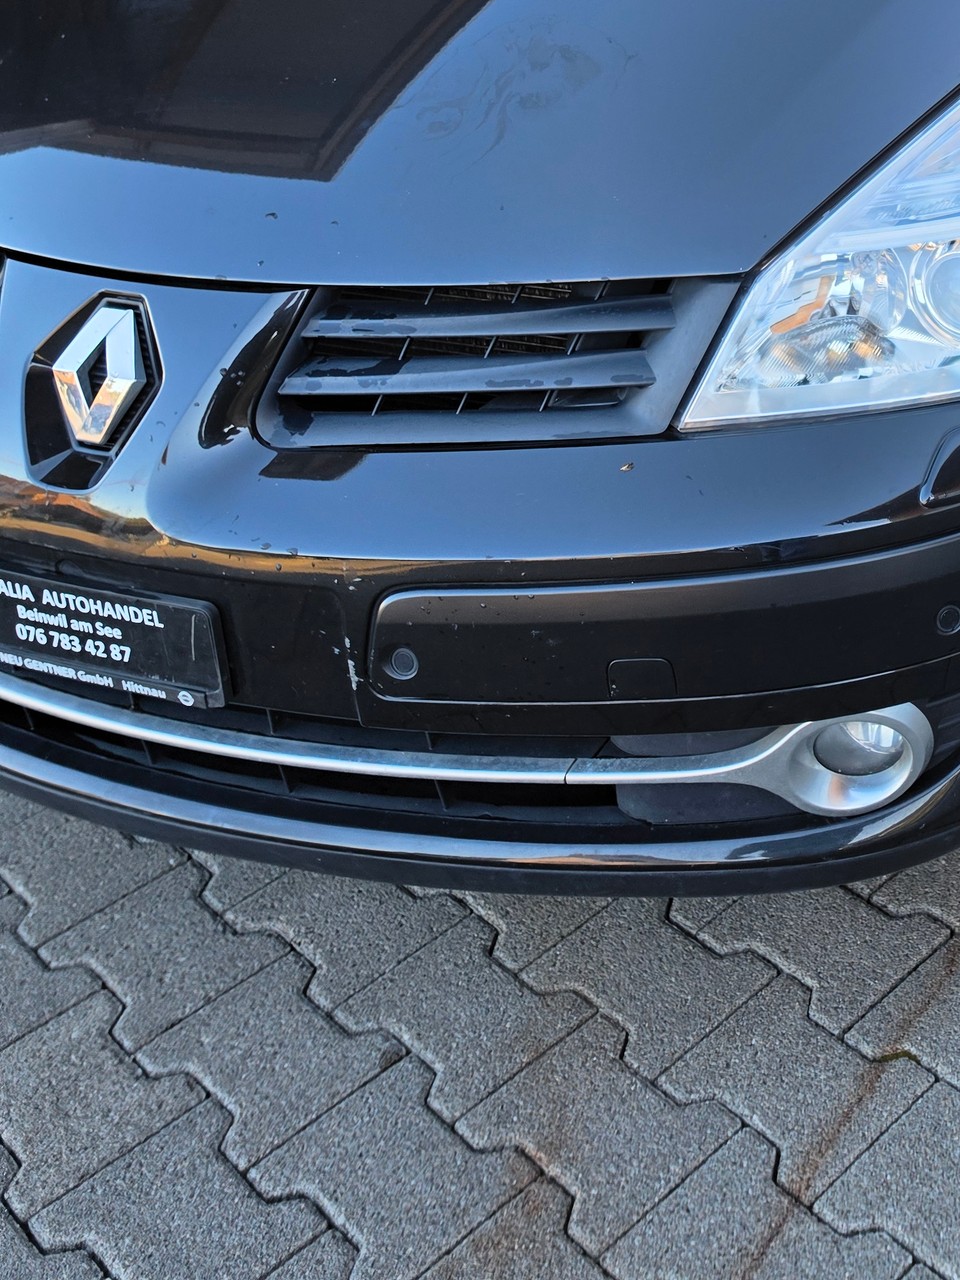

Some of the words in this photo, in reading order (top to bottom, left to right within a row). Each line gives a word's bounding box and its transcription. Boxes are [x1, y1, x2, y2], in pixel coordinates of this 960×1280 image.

[0, 579, 35, 602] ALIA
[42, 589, 165, 629] AUTOHANDEL
[16, 605, 67, 629] Beinwil
[70, 617, 94, 634] am
[95, 622, 122, 640] See
[15, 623, 47, 646] 076
[49, 630, 82, 653] 783
[85, 639, 107, 658] 42
[109, 644, 131, 663] 87
[77, 670, 114, 688] GmbH
[121, 680, 167, 699] Hittnau
